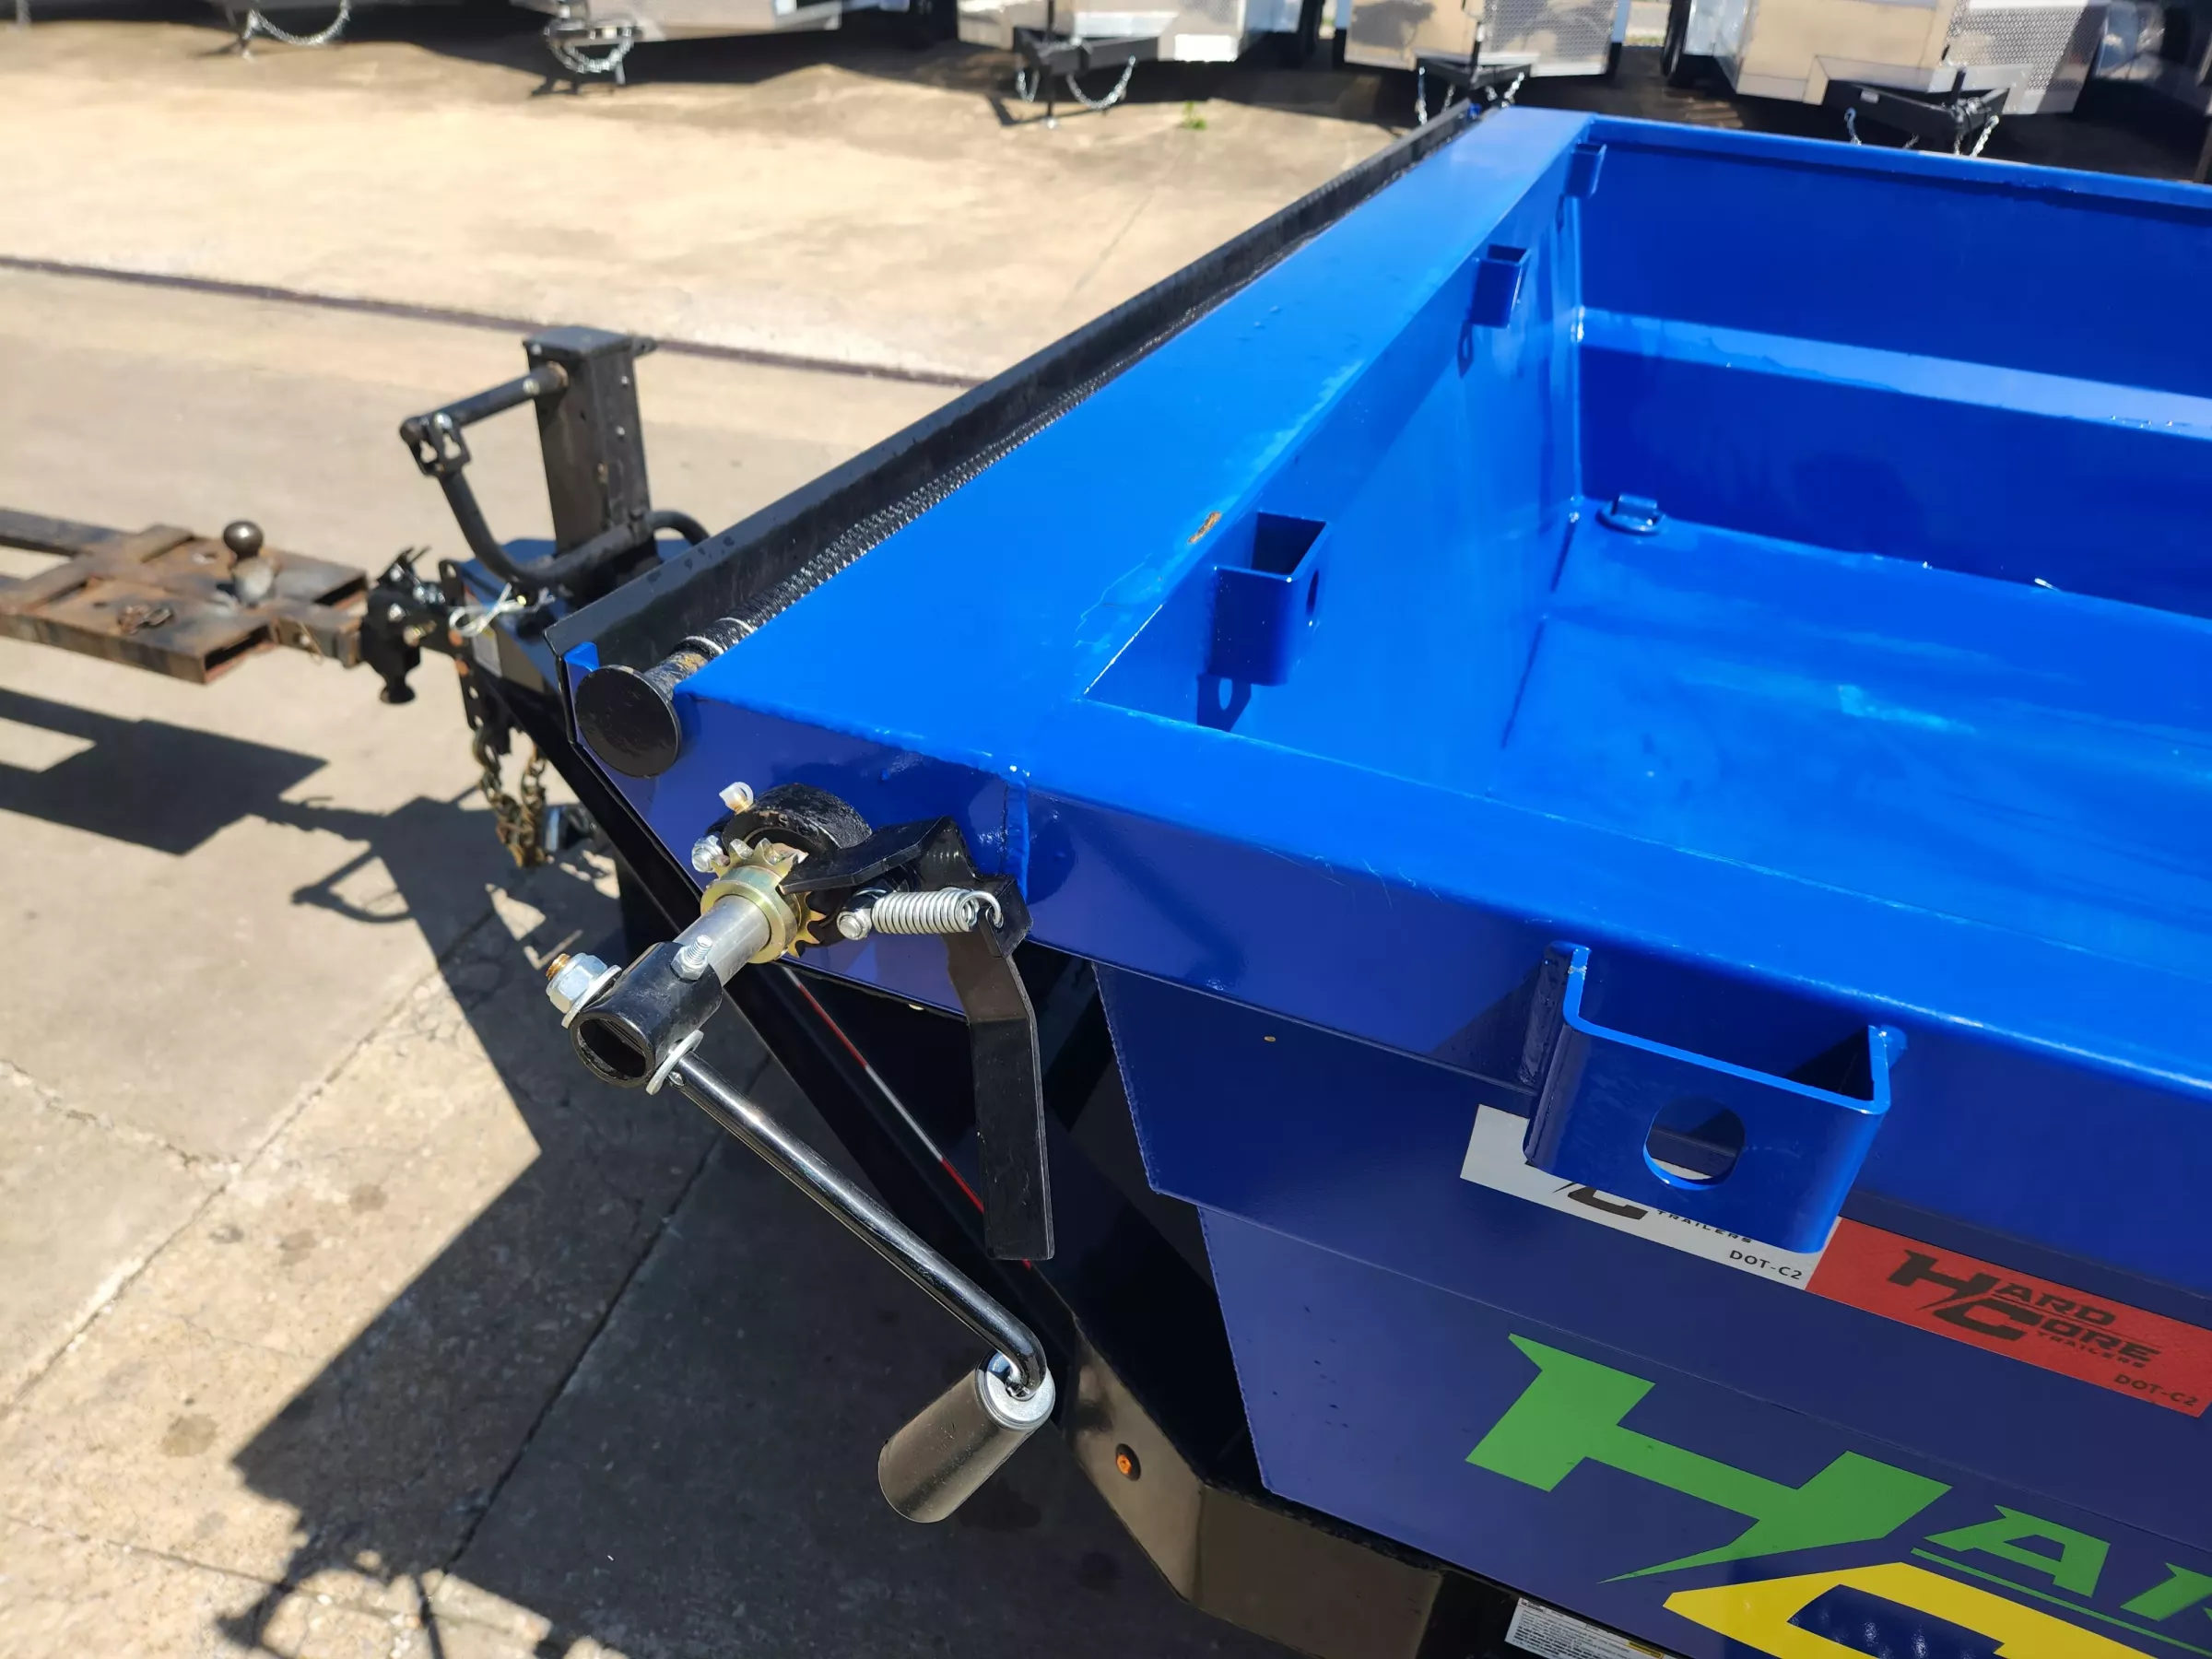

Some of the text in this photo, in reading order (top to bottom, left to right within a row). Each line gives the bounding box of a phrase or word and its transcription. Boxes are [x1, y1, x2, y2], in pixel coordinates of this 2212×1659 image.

[1729, 1250, 1803, 1280] DOT-C2
[1887, 1249, 2116, 1326] HARD
[1933, 1299, 2161, 1363] CORE
[2037, 1332, 2146, 1369] TRAILERS
[2114, 1373, 2198, 1407] DOT-C2
